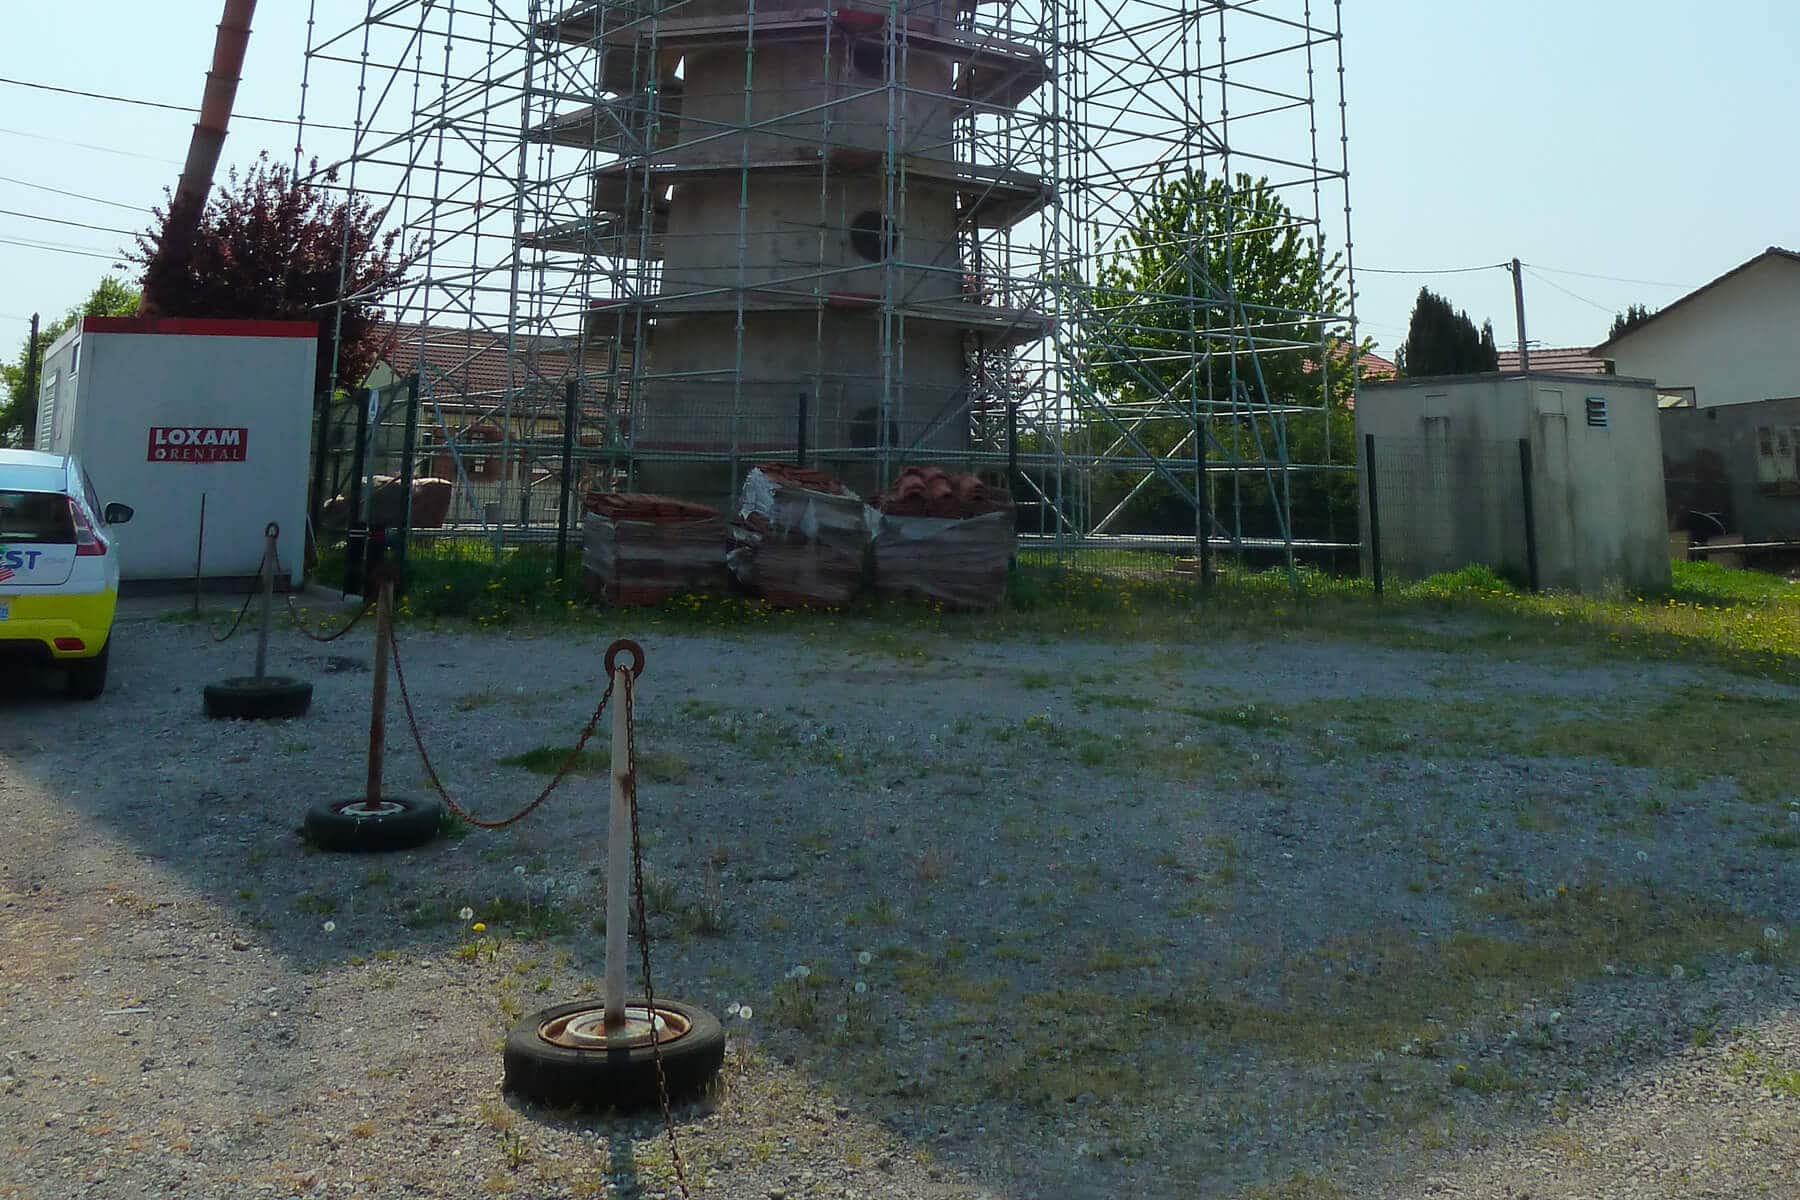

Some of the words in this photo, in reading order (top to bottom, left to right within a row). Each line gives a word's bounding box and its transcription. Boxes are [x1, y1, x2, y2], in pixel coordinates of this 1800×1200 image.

[155, 429, 240, 445] LOXAM
[170, 448, 240, 459] RENTAL
[0, 550, 42, 570] ST
